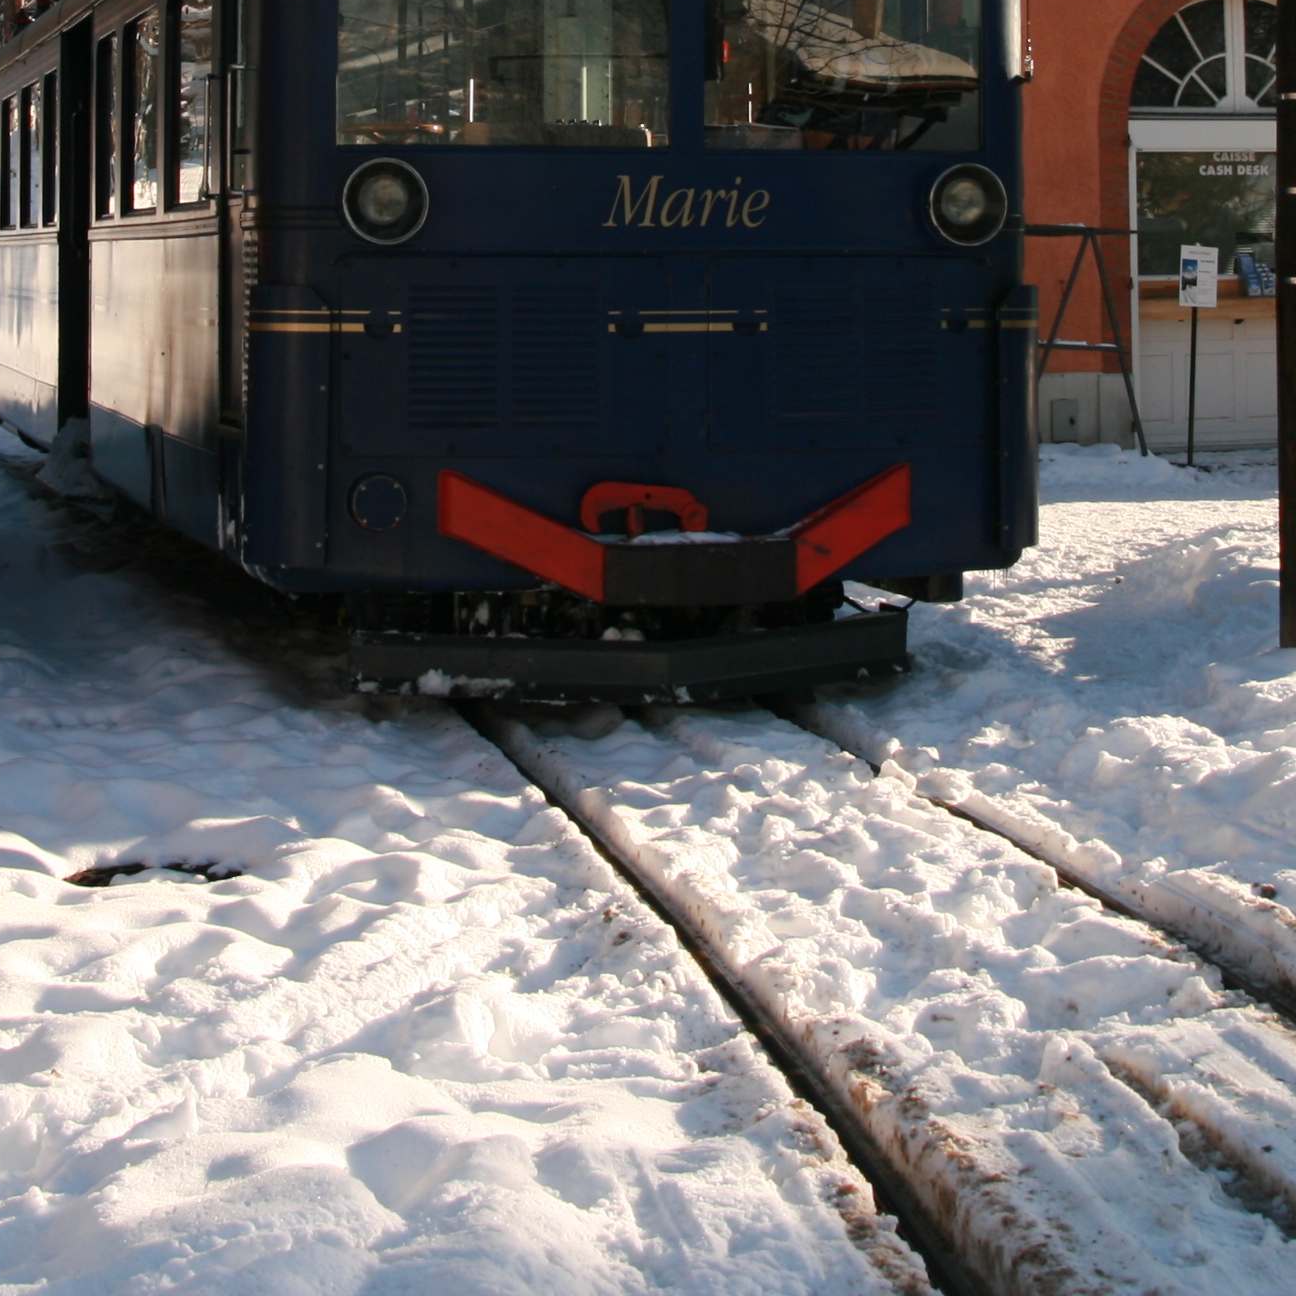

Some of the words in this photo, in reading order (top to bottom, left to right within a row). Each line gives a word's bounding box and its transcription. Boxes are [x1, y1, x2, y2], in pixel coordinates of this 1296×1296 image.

[1212, 152, 1256, 162] CAISSE
[1199, 164, 1233, 176] CASH
[1236, 164, 1270, 176] DESK
[602, 174, 771, 228] Marie
